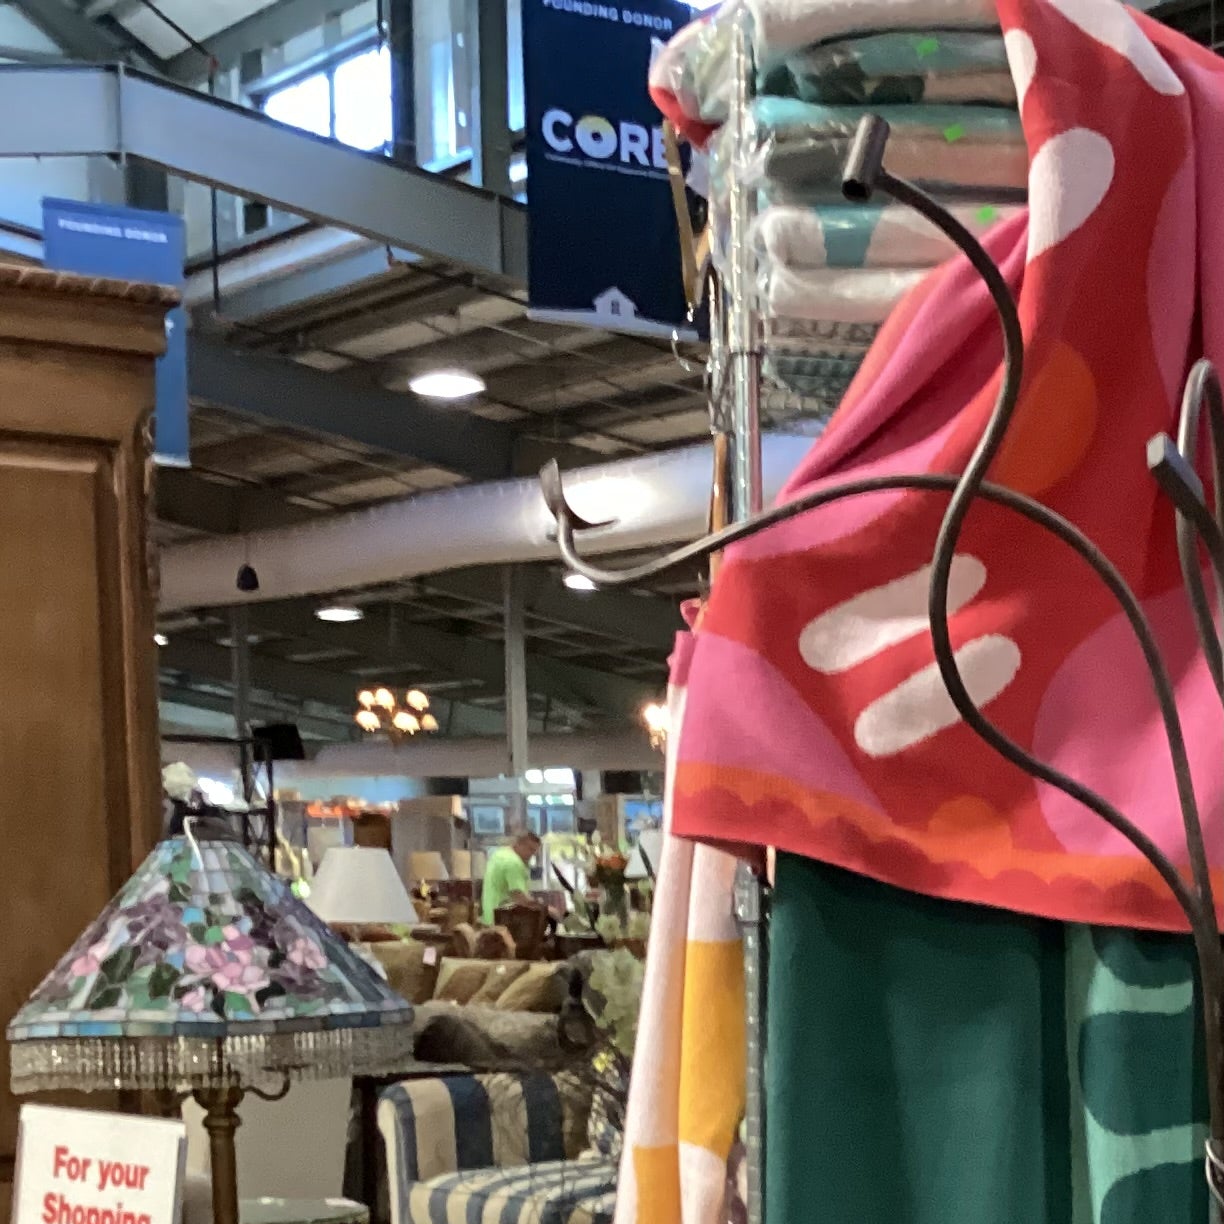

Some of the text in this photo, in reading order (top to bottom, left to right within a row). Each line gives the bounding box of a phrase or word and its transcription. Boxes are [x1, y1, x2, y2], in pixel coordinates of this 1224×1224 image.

[622, 9, 673, 31] DONOR
[541, 107, 669, 169] CORE
[52, 1145, 150, 1192] For your
